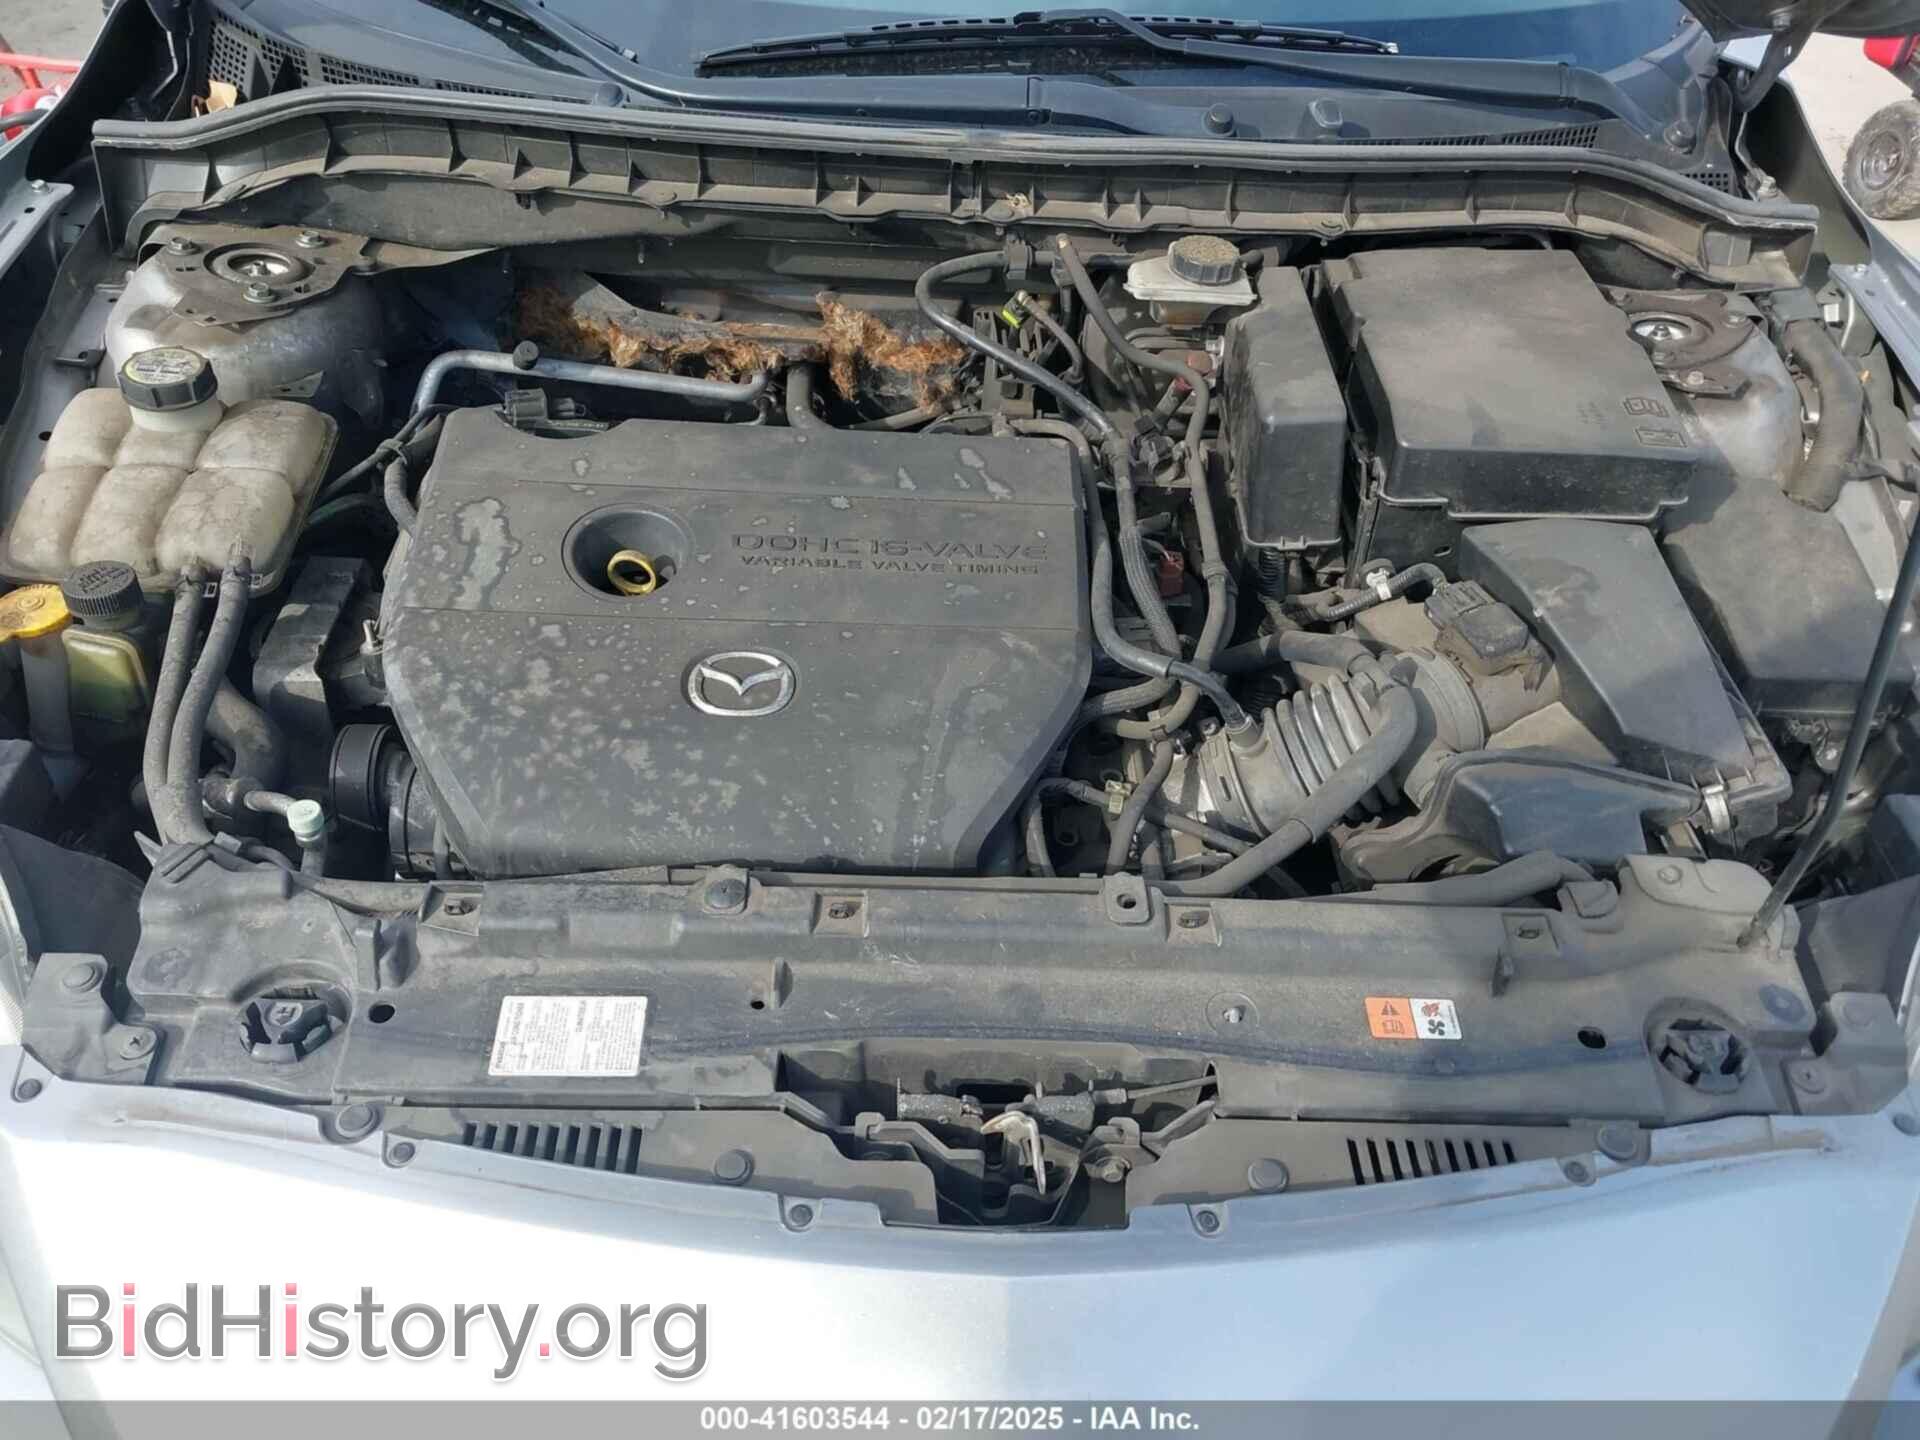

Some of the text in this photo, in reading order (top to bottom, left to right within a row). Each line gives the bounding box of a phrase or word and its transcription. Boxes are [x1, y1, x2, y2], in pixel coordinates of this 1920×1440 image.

[732, 535, 860, 555] DOHC
[741, 556, 1039, 576] VARIABLE VALVE TIMING
